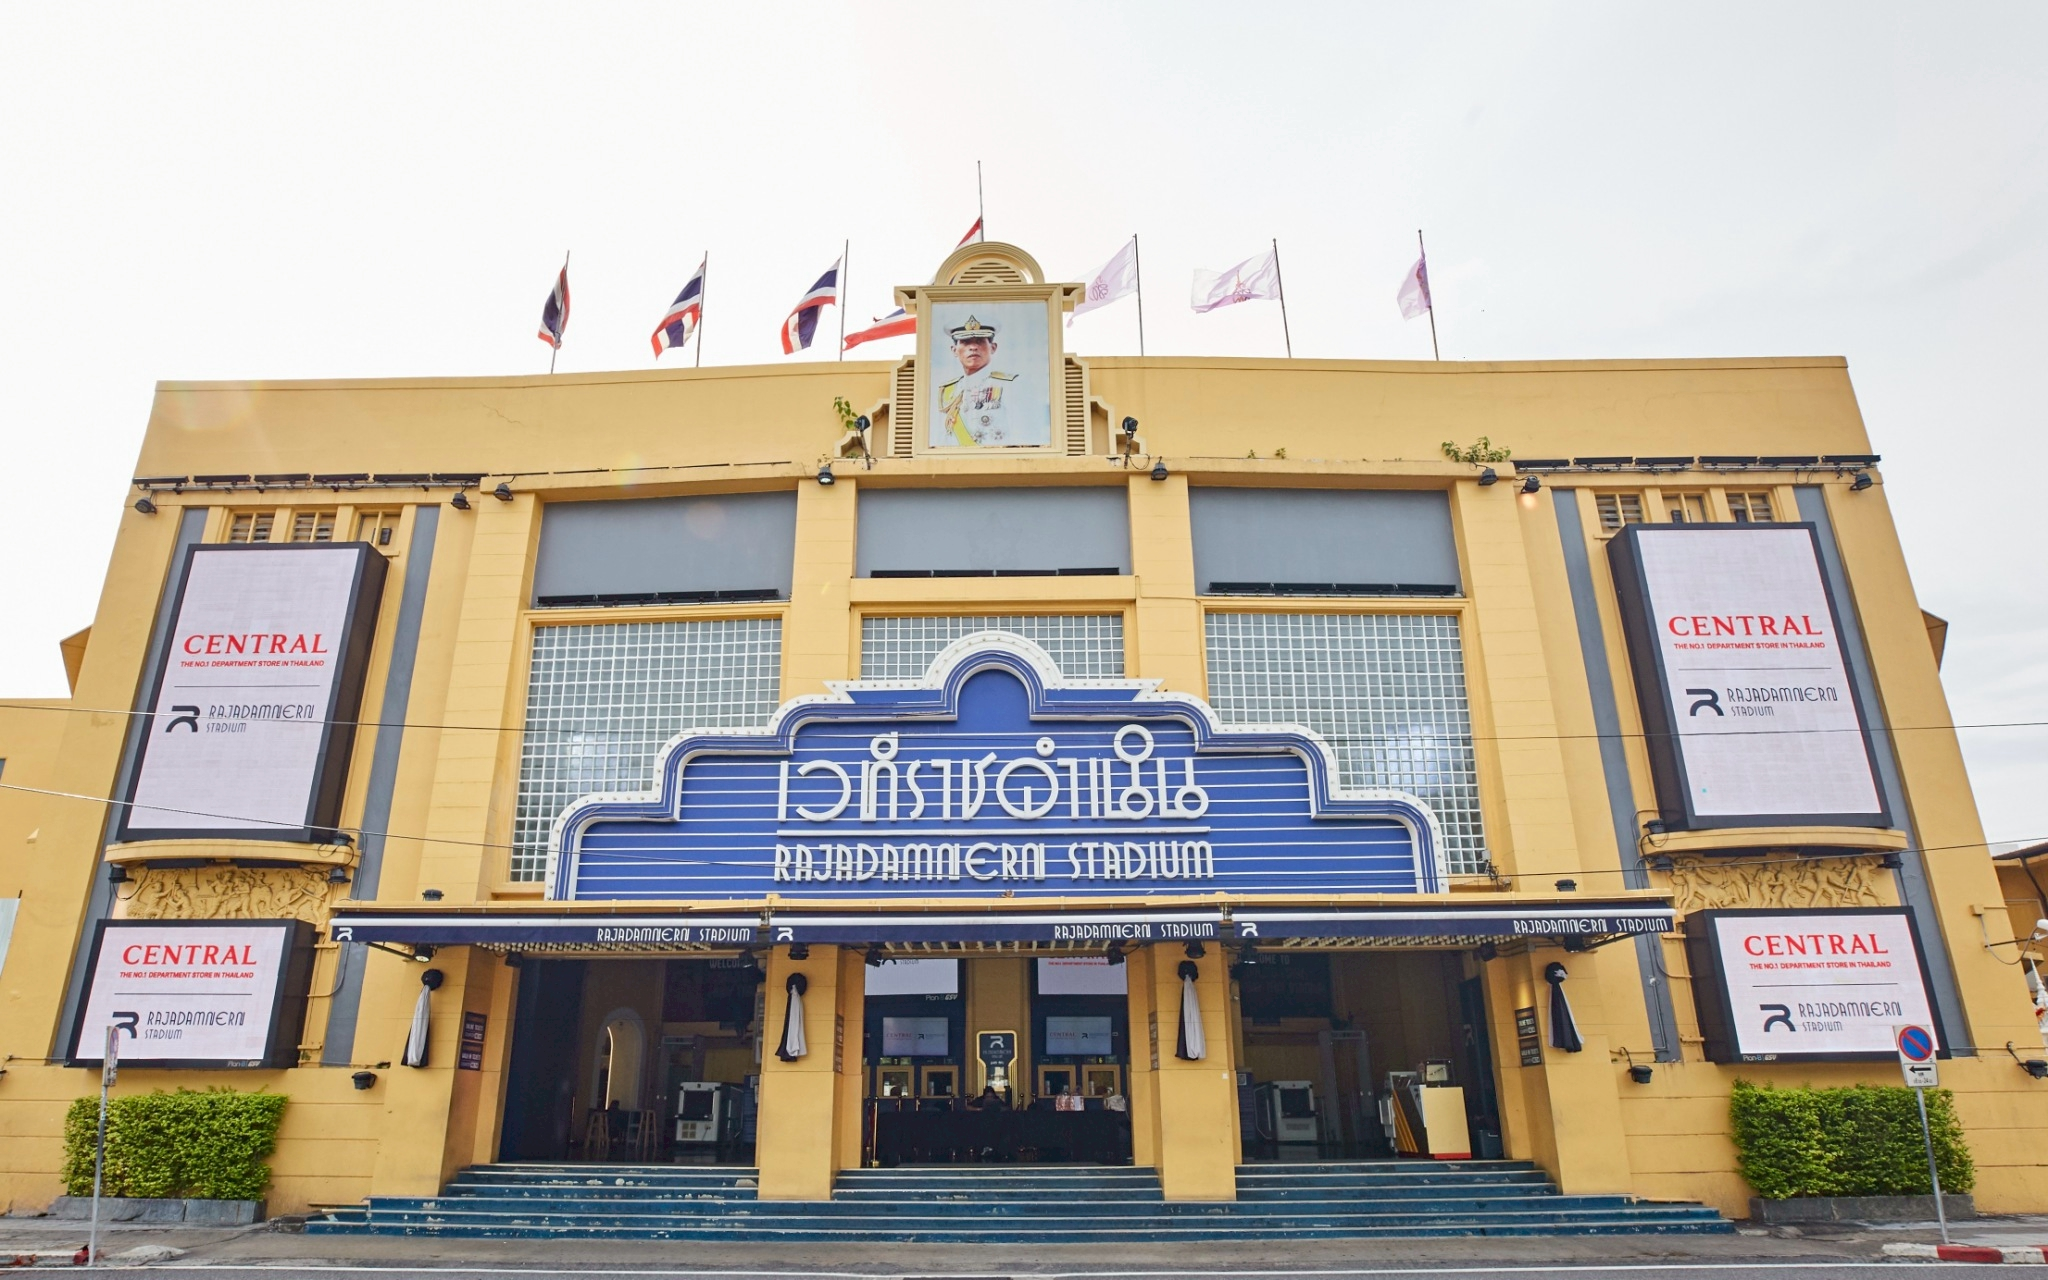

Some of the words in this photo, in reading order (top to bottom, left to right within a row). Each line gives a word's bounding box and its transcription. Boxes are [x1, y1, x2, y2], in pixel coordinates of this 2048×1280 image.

[1668, 616, 1822, 636] CENTRAL
[184, 634, 328, 654] CENTRAL
[1726, 687, 1838, 702] RAJADAMNERN
[209, 704, 315, 719] RAJADAMNERN
[1730, 706, 1774, 717] STADIUM
[206, 722, 246, 733] STADIUM
[774, 842, 1046, 882] RAJADAMNERN
[1068, 840, 1214, 880] STADIUM
[1054, 924, 1151, 939] RAJADAMNERN
[1160, 923, 1214, 938] STADIUM
[1513, 918, 1608, 934] RAJADAMNERN
[1616, 918, 1668, 932] STADIUM
[597, 928, 690, 942] RAJADAMNERN
[700, 928, 750, 942] STADIUM
[1744, 934, 1888, 956] CENTRAL
[122, 945, 257, 965] CENTRAL
[1798, 1001, 1902, 1018] RAJADAMNERN
[147, 1011, 246, 1026] RAJADAMNERN
[1802, 1021, 1843, 1032] STADIUM
[145, 1029, 182, 1040] STADIUM
